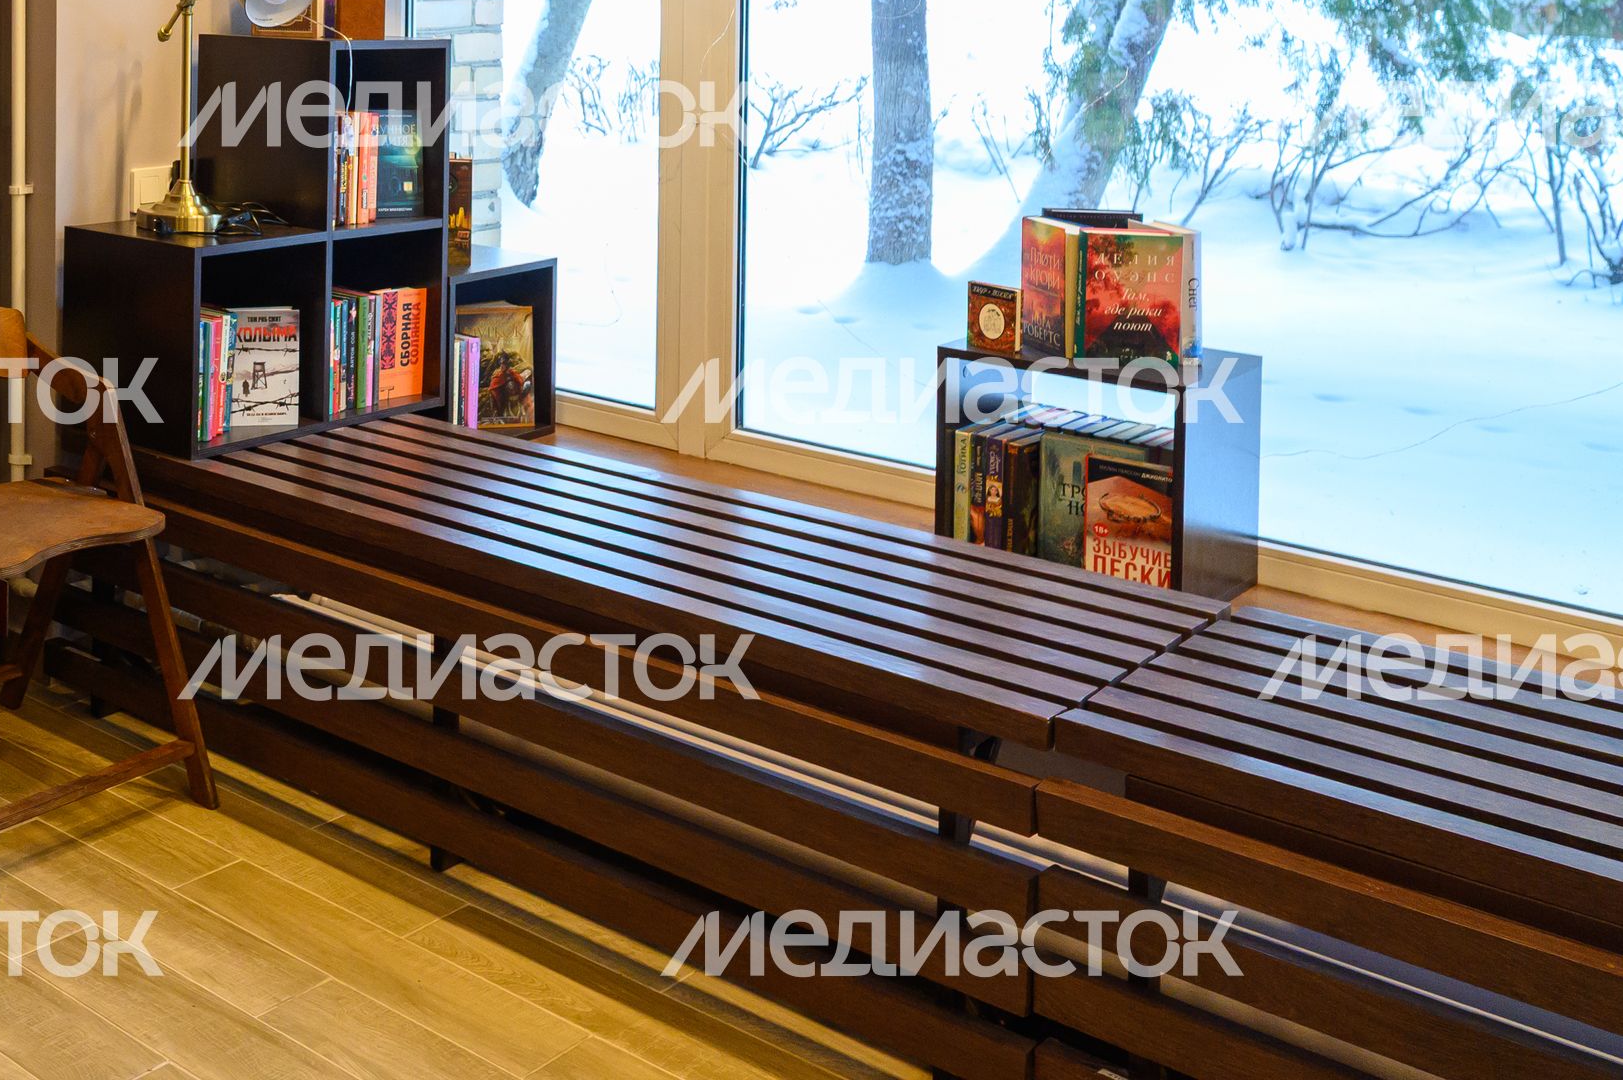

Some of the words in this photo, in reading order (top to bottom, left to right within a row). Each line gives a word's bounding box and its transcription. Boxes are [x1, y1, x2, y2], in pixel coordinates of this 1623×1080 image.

[1095, 253, 1175, 267] ДЕЛИЯ
[1095, 269, 1175, 283] ОУЭНС
[1120, 286, 1151, 303] Там,
[1104, 304, 1125, 318] где
[1126, 306, 1164, 318] раки
[1113, 320, 1153, 334] поют
[236, 325, 297, 344] КОЛЫМА
[400, 302, 413, 367] СБОРНАЯ
[1094, 524, 1109, 535] 18+
[1092, 538, 1172, 569] ЗЫБУЧИЕ
